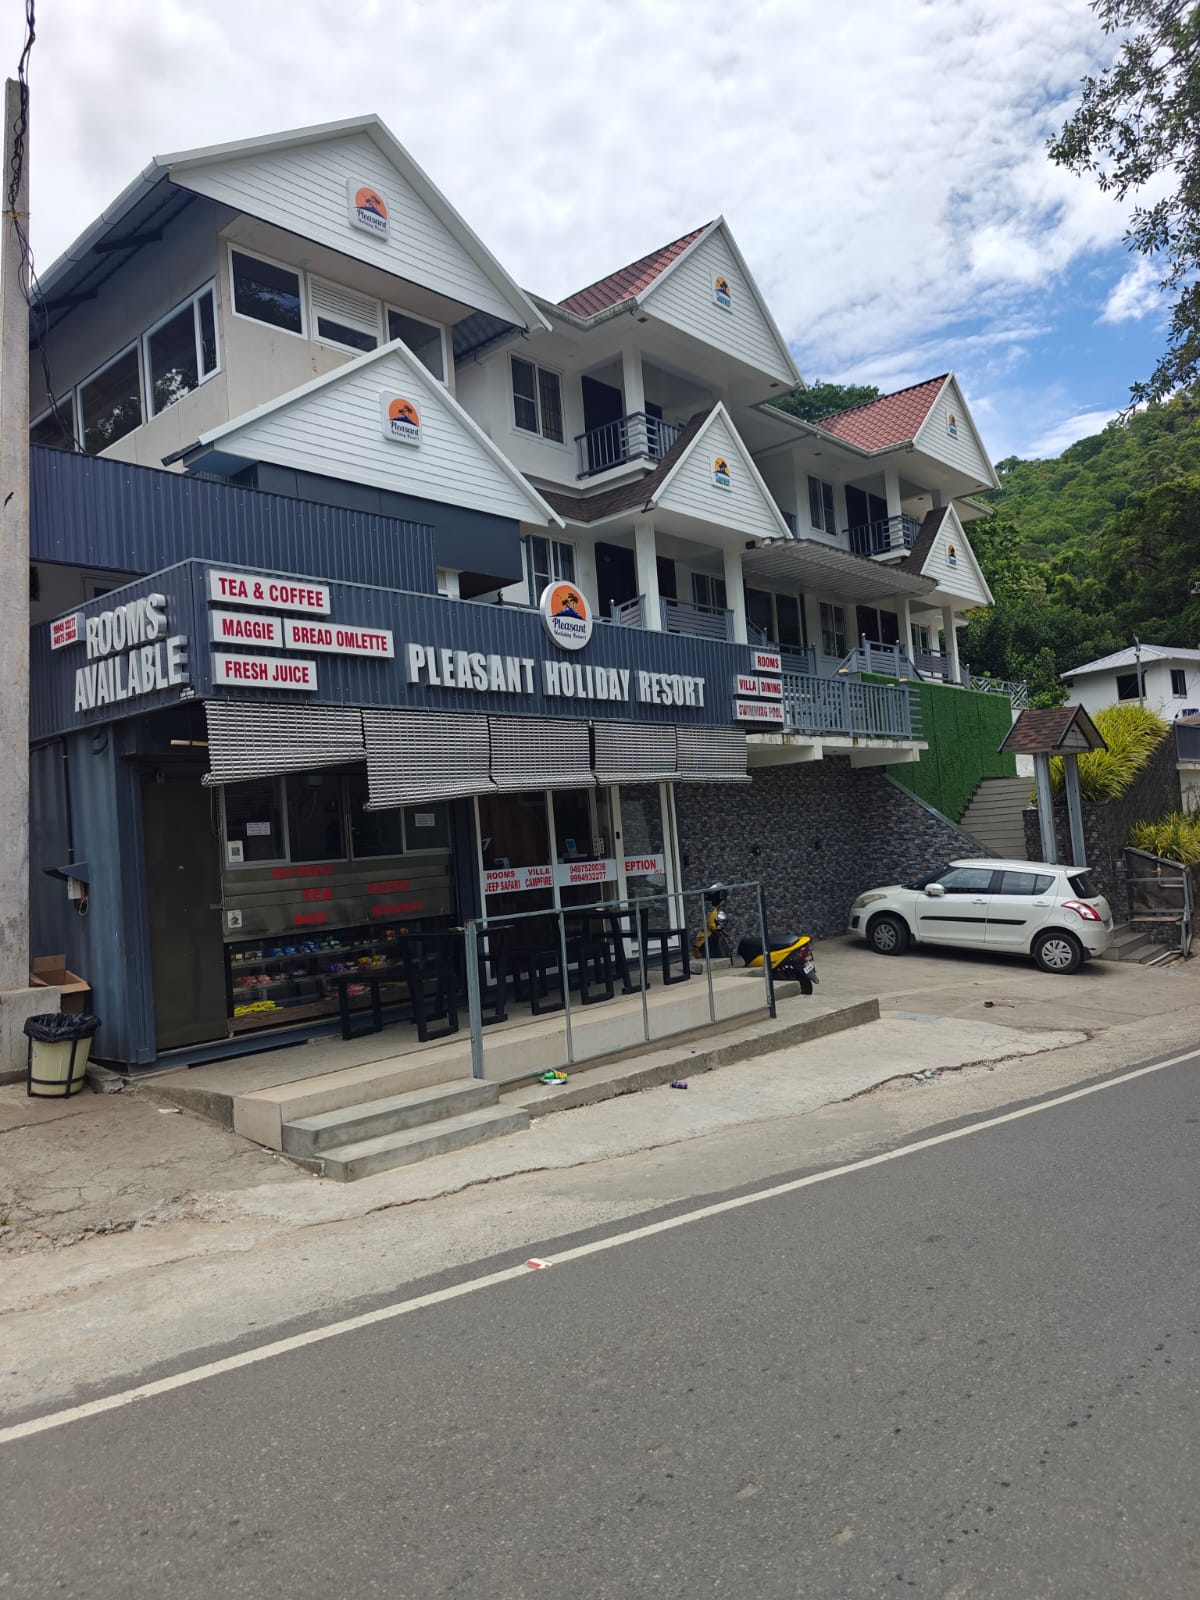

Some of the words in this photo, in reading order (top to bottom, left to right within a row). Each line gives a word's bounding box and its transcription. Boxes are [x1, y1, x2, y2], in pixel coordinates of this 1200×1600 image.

[357, 208, 387, 228] Pleasant
[390, 421, 419, 436] Pleasant
[218, 577, 250, 598] TEA
[253, 582, 264, 600] &
[268, 584, 324, 608] COFFEE
[86, 593, 167, 660] ROOMS
[222, 617, 275, 641] MAGGIE
[552, 618, 586, 633] Pleasant
[292, 626, 333, 647] BREAD
[336, 630, 389, 652] OMLETTE
[757, 655, 779, 669] ROOMS
[74, 635, 189, 713] AVAILABLE
[225, 660, 269, 682] FRESH
[272, 664, 310, 684] JUICE
[408, 642, 535, 694] PLEASANT
[543, 659, 630, 702] HOLIDAY
[636, 669, 706, 708] RESORT
[739, 678, 757, 692] VILLA
[761, 681, 781, 694] DINING
[768, 706, 783, 719] POOL
[486, 870, 516, 880] ROOMS
[527, 867, 550, 876] VILLA
[484, 881, 500, 893] JEEP
[500, 879, 521, 891] SAFARI
[525, 876, 553, 889] CAMPFIRE
